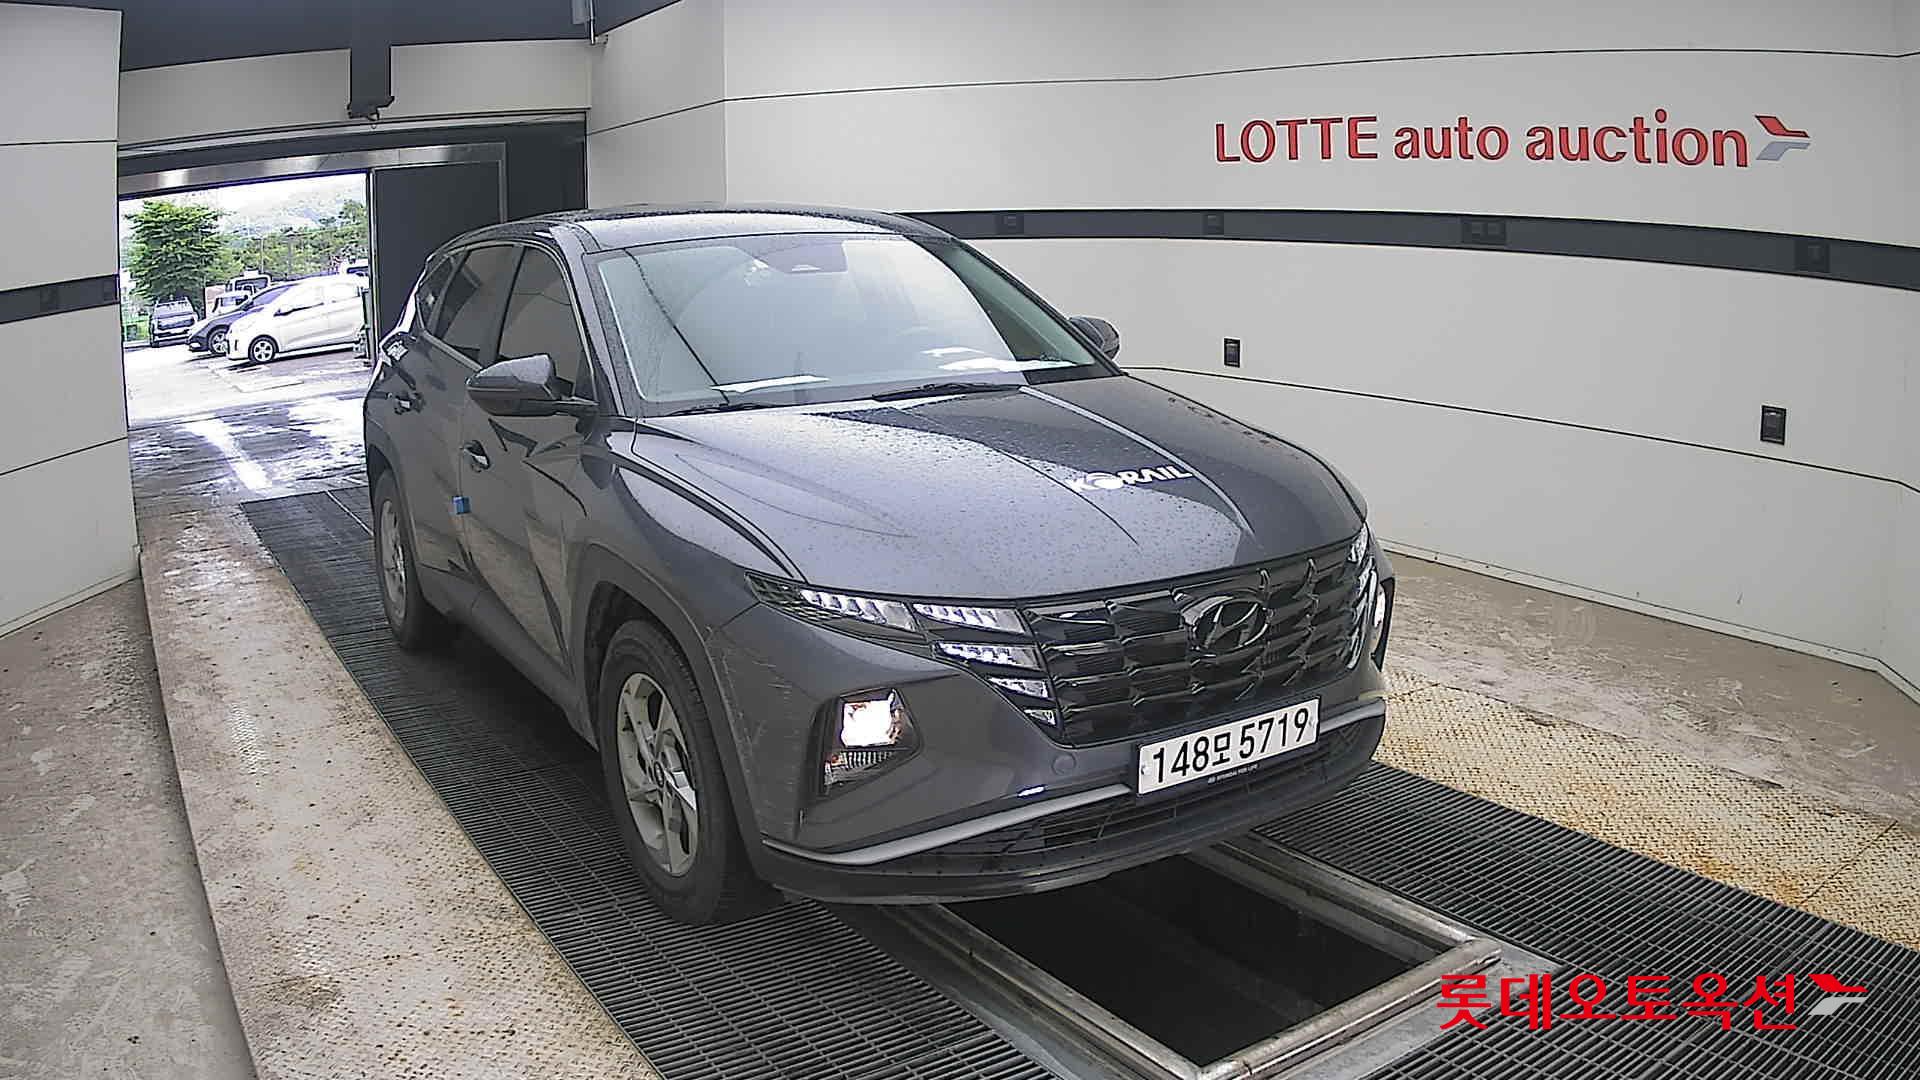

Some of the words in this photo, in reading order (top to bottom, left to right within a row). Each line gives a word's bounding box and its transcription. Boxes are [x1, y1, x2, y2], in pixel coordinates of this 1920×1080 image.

[1215, 116, 1377, 162] LOTTE
[1394, 117, 1510, 161] auto
[1526, 109, 1749, 167] auction
[1153, 732, 1231, 783] 148모
[1239, 708, 1309, 759] 5719
